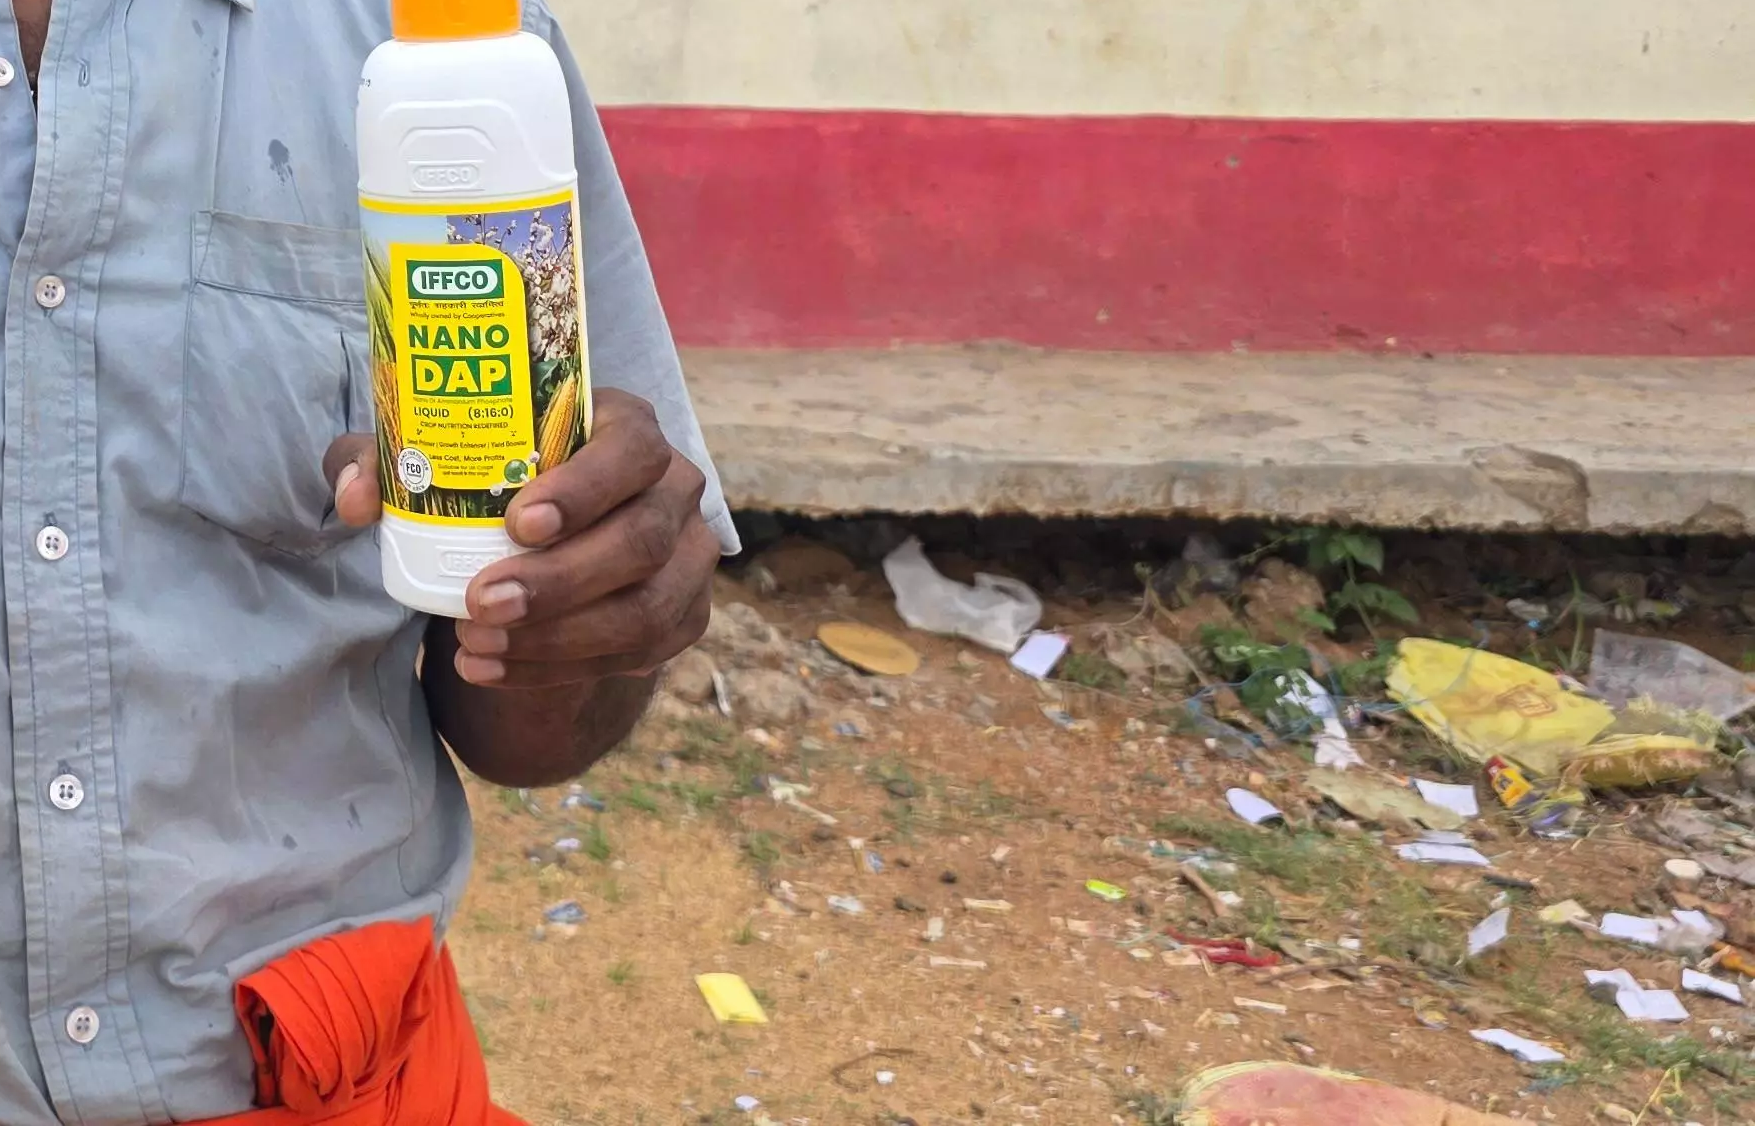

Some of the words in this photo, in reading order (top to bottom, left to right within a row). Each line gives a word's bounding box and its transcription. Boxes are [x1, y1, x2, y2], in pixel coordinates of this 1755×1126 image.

[420, 168, 471, 183] IFFCO
[420, 270, 489, 290] IFFCO
[410, 312, 430, 320] Wholly
[453, 312, 461, 320] by
[408, 324, 510, 350] NANO
[415, 359, 507, 393] DAP
[413, 406, 450, 419] LIQUID
[468, 404, 514, 420] (8:16:0)
[420, 421, 437, 429] CROP
[474, 421, 509, 429] REDEFINED
[459, 441, 487, 449] Enhancer
[428, 453, 443, 461] Less
[406, 462, 421, 474] FCO
